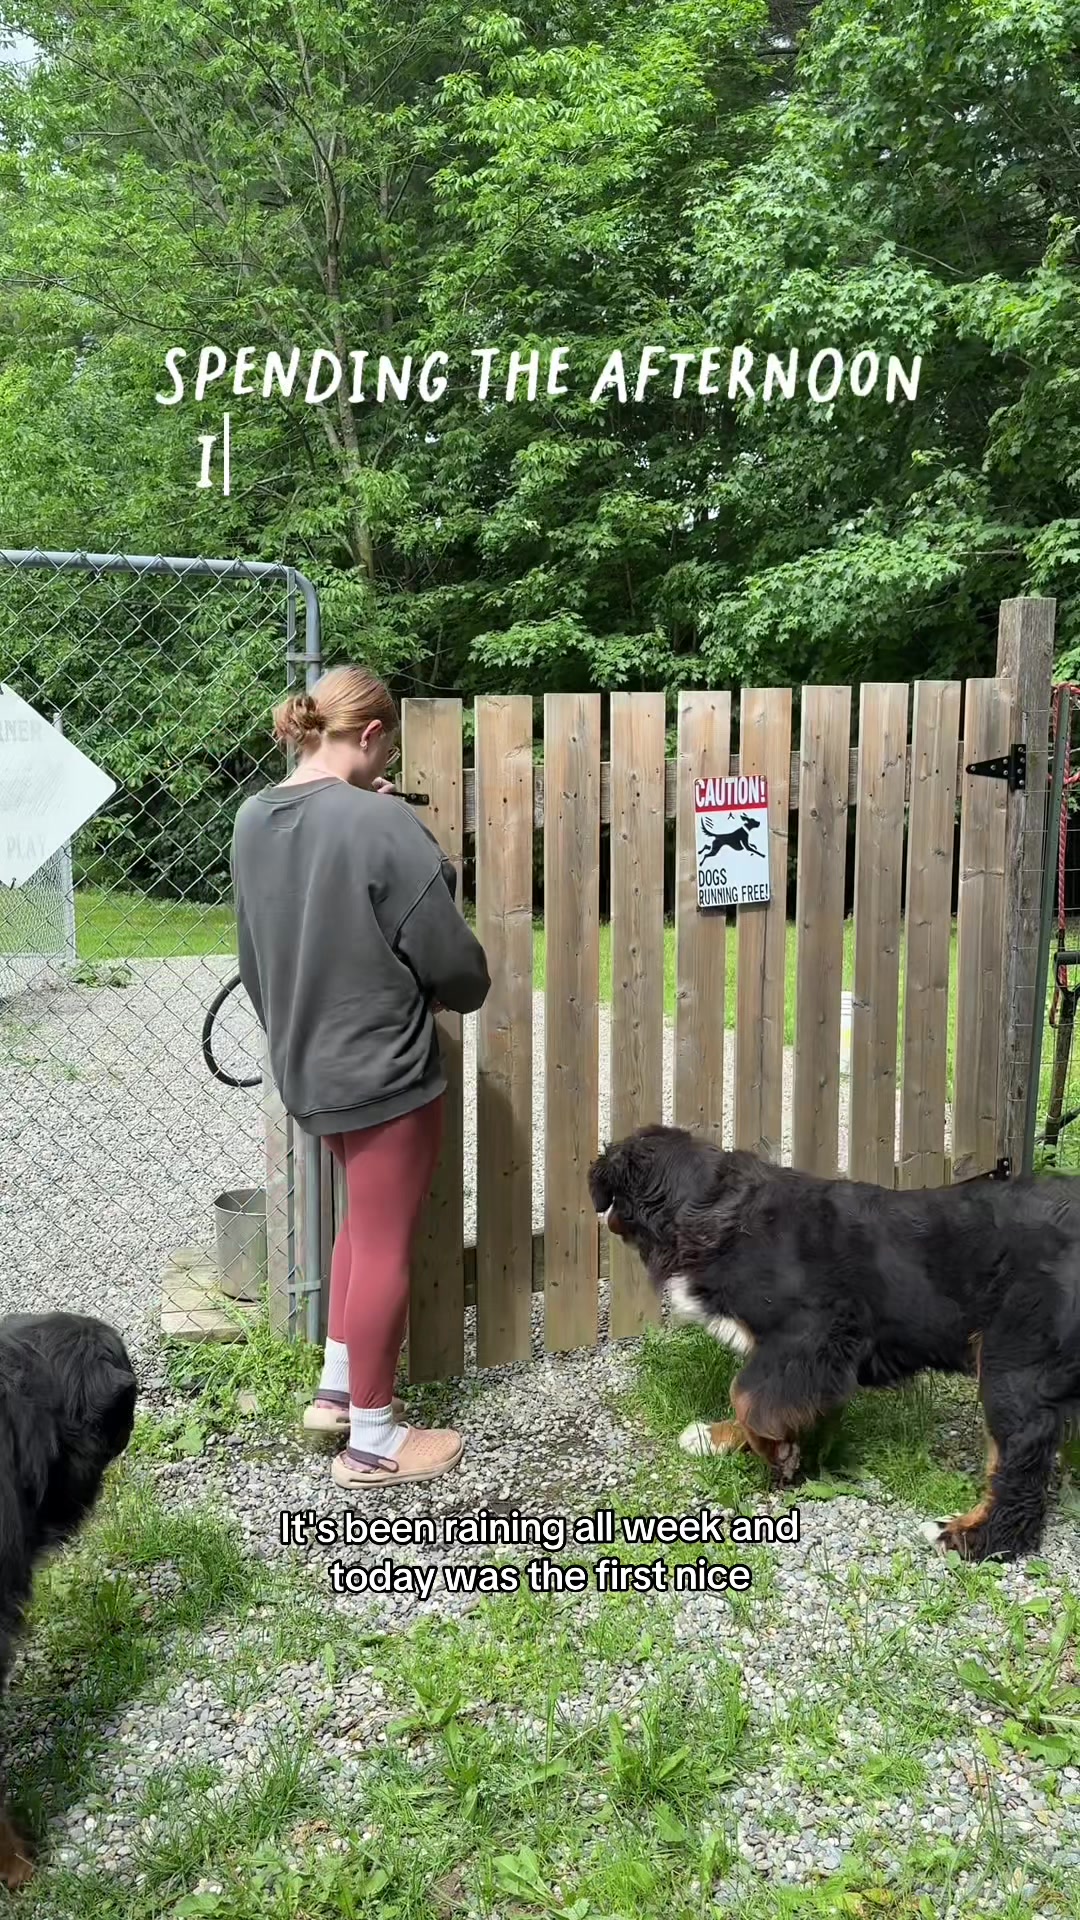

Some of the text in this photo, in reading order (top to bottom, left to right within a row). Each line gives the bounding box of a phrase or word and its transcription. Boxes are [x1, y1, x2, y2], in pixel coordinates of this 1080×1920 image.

[695, 776, 767, 807] CAUTION!
[698, 868, 728, 888] DOGS
[699, 883, 769, 905] RUNNING FREE!
